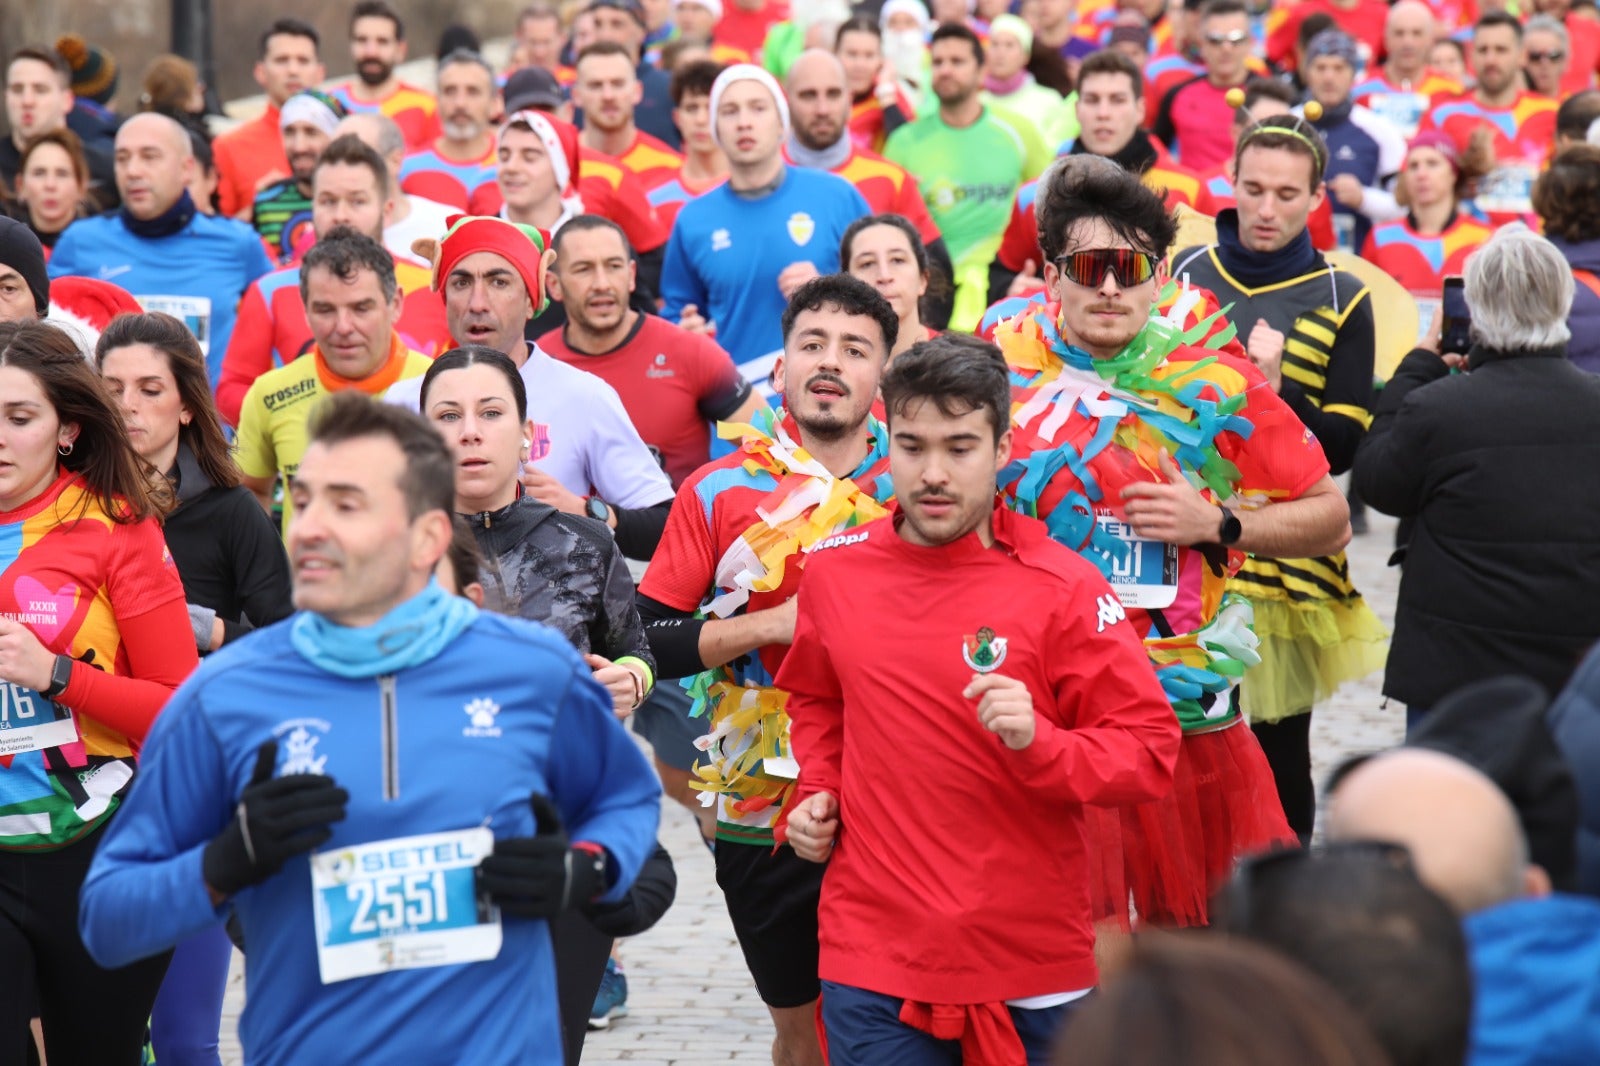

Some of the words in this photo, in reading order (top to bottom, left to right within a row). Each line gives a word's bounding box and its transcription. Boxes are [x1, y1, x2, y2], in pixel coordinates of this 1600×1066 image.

[28, 600, 58, 612] XXXIX
[361, 840, 476, 874] SETEL
[346, 869, 449, 935] 2551
